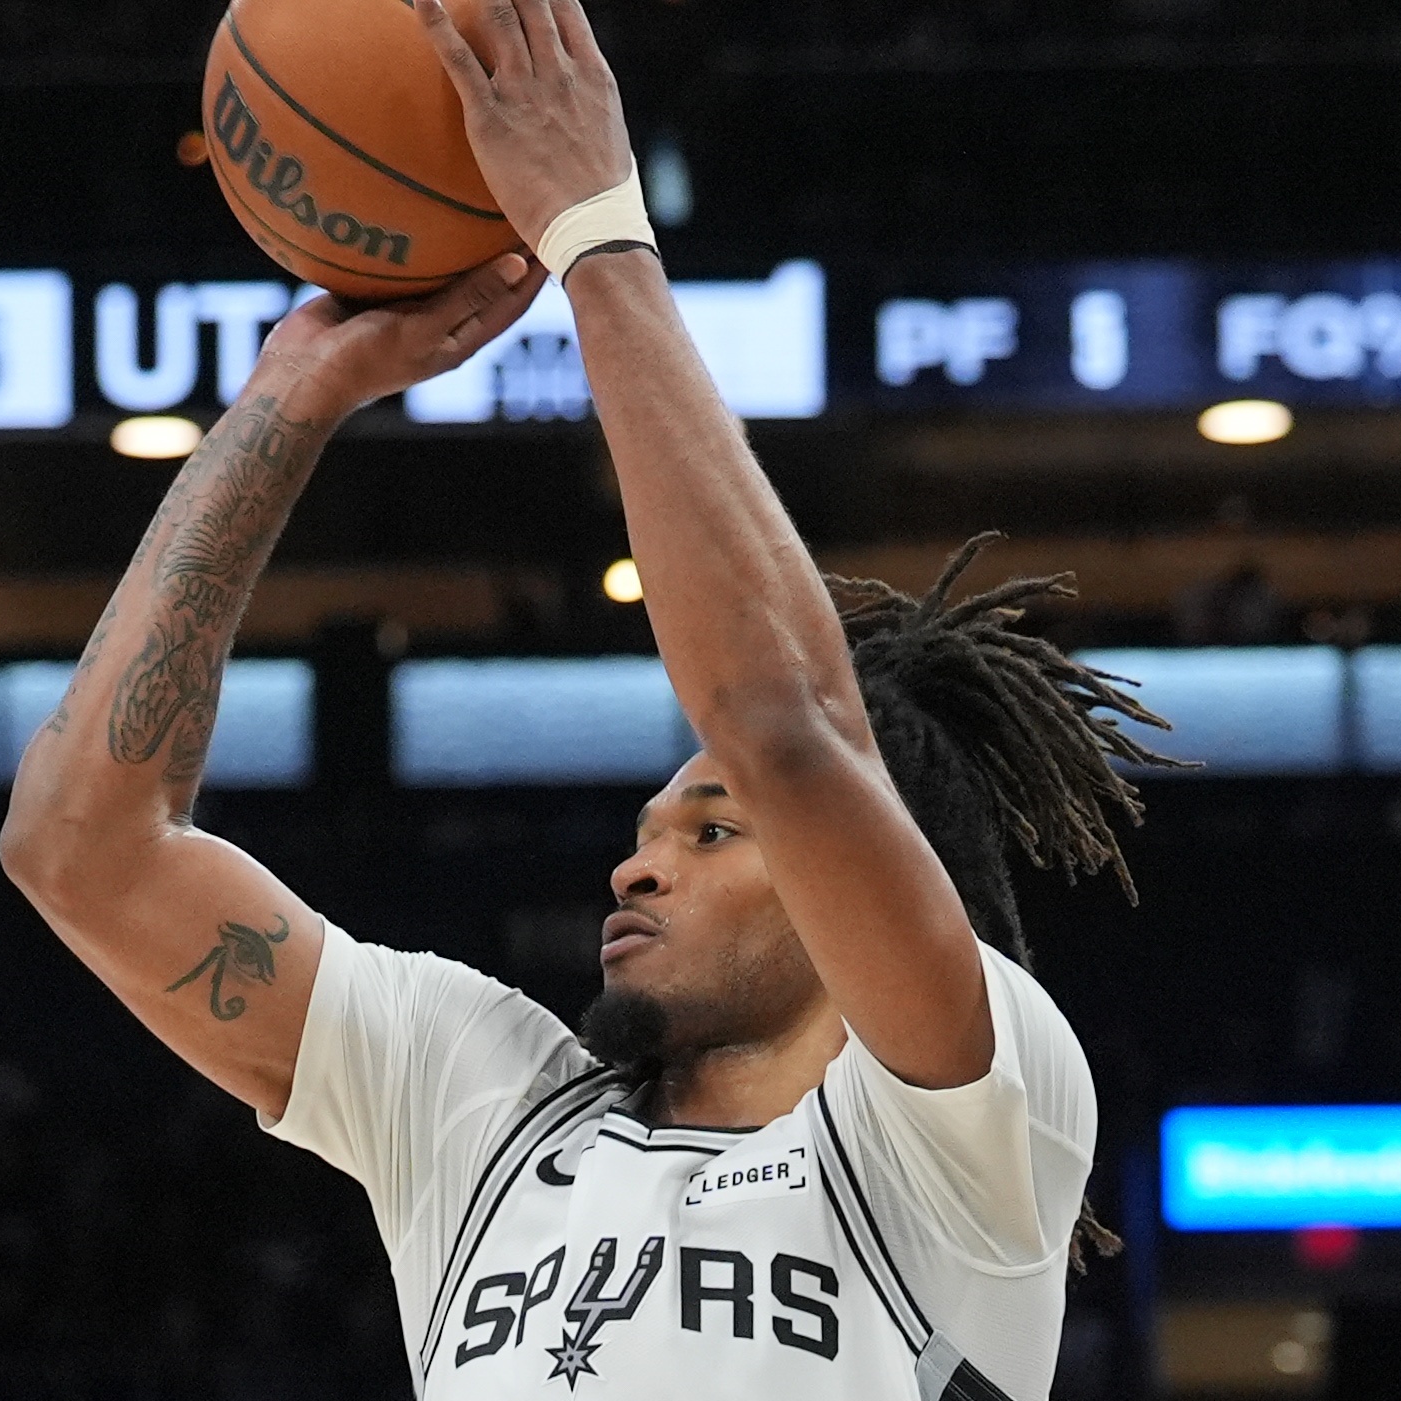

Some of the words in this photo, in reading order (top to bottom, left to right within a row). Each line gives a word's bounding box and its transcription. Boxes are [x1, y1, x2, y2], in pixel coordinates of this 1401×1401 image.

[213, 70, 412, 266] Wilson
[95, 281, 331, 412] UT
[875, 298, 1018, 386] PF
[702, 1162, 790, 1193] LEDGER
[455, 1236, 840, 1392] SPURS
